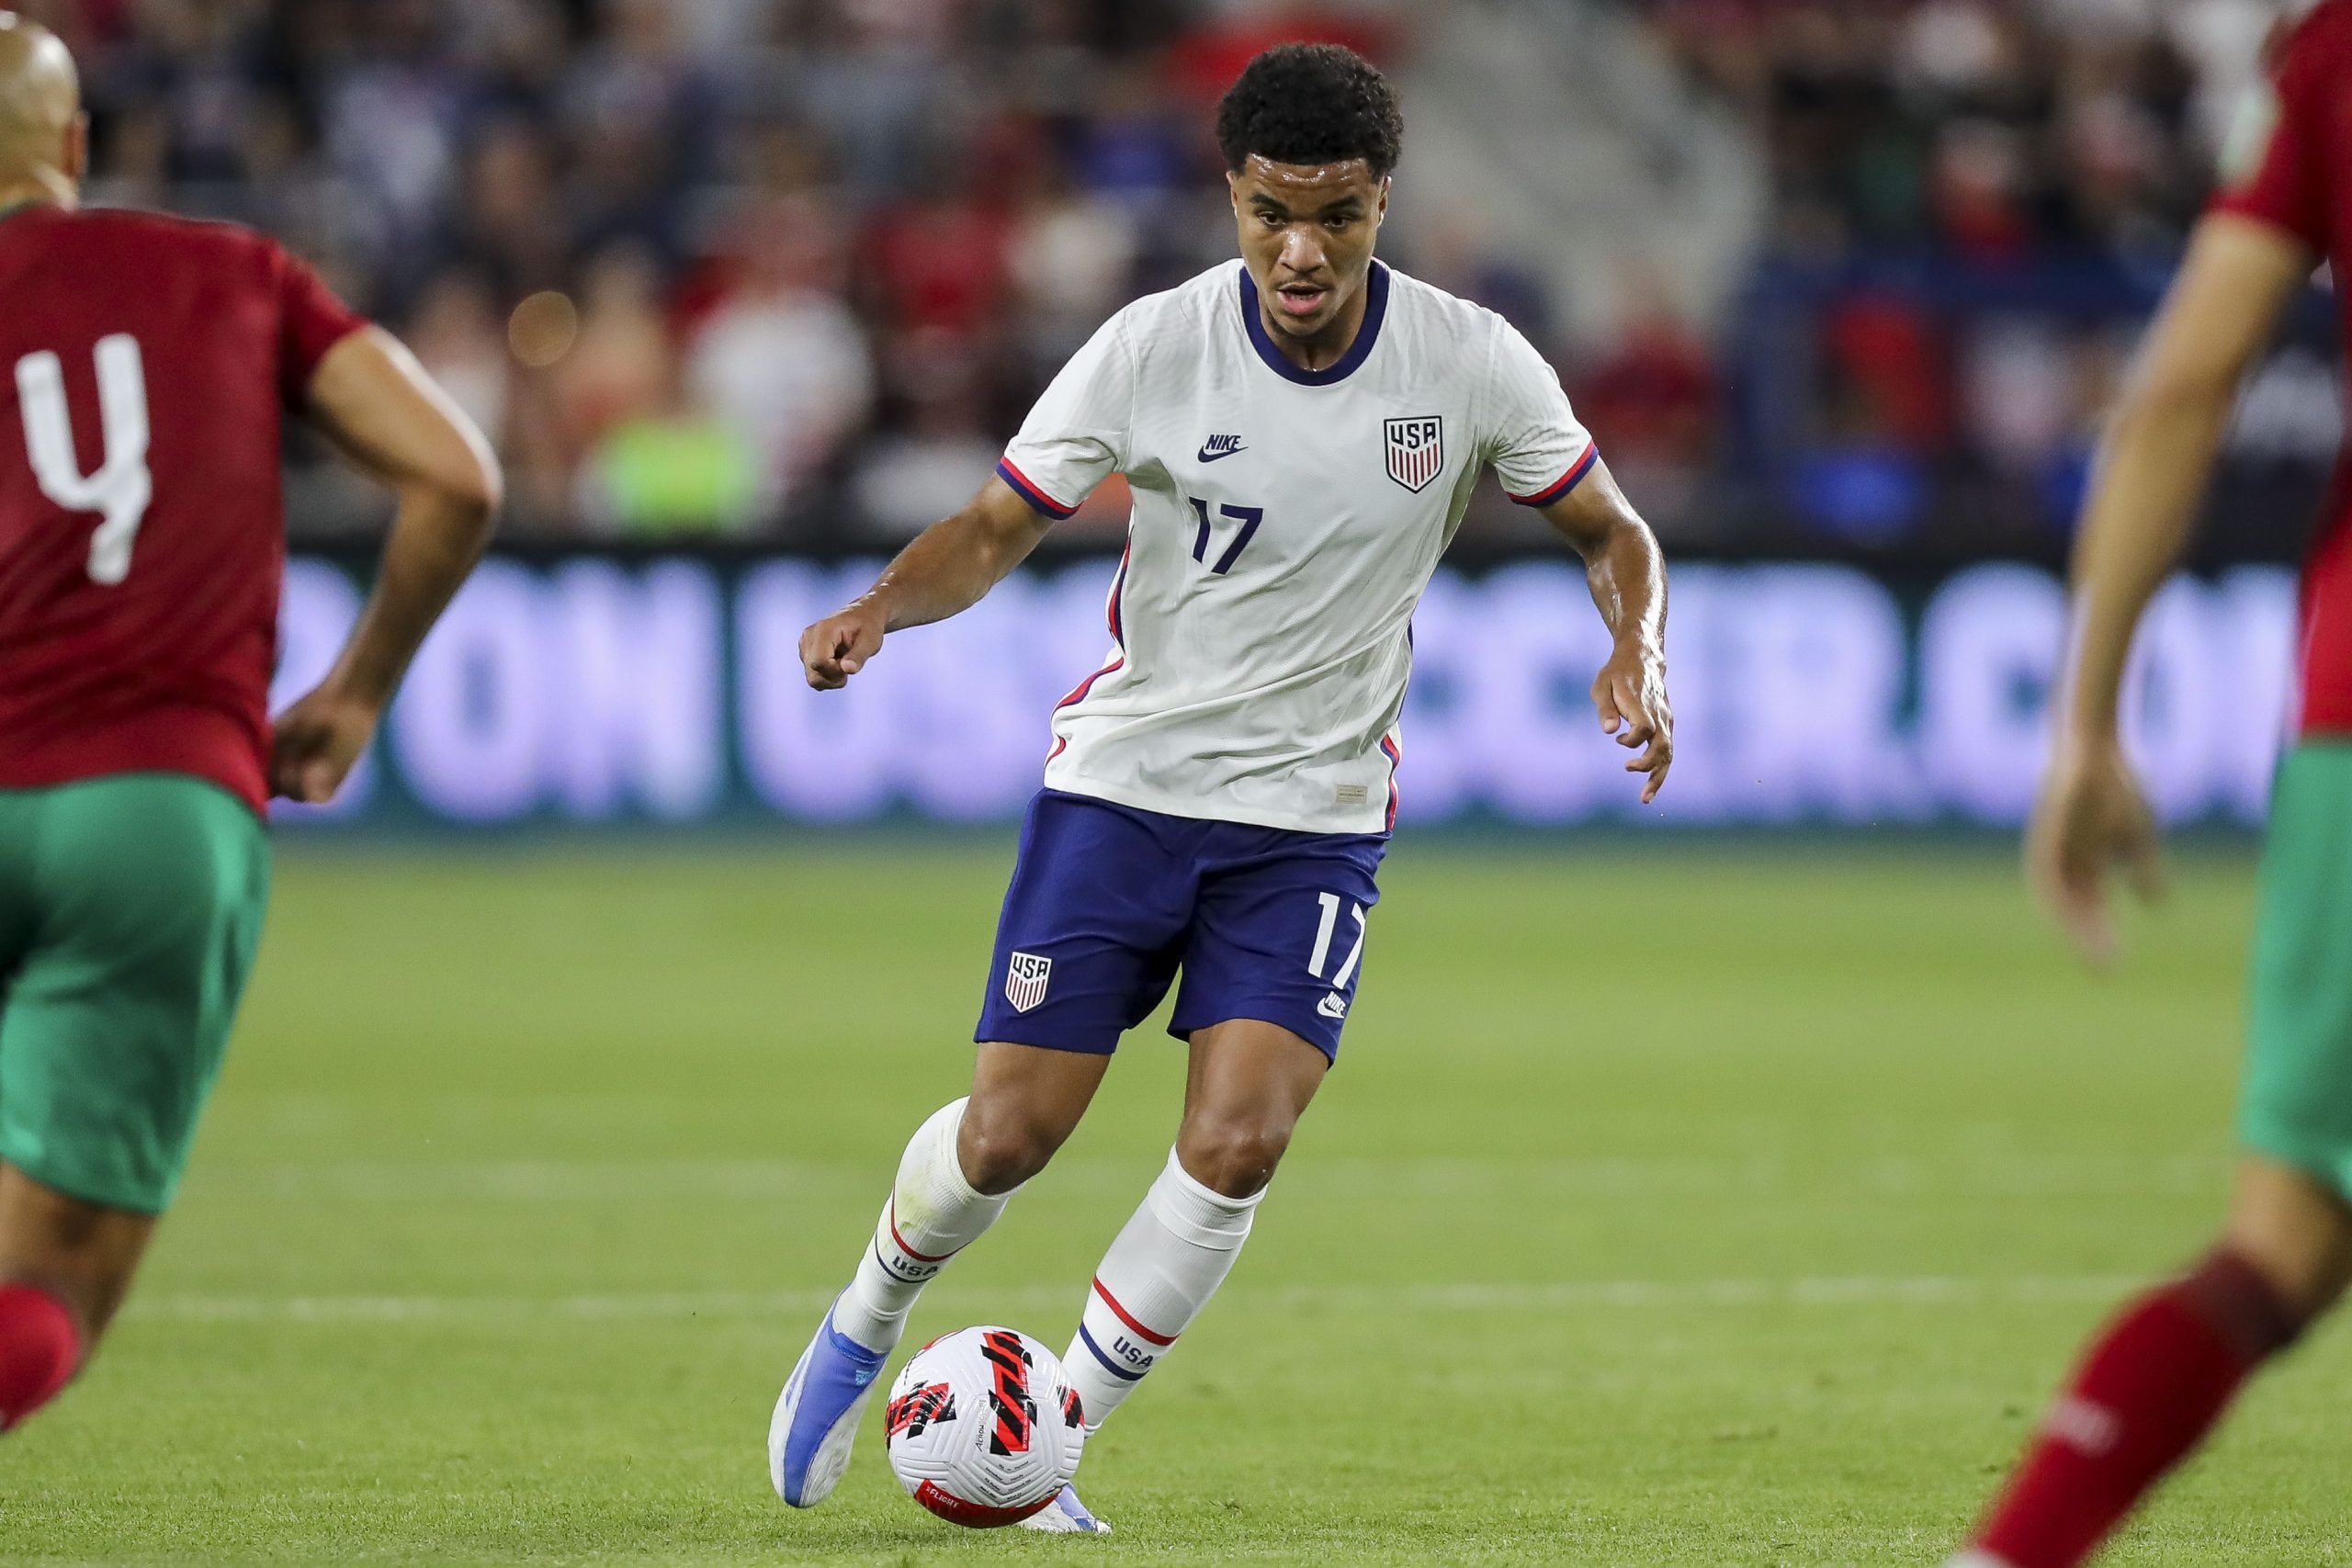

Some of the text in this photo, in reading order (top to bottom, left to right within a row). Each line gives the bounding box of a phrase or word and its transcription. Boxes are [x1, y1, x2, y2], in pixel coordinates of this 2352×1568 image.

[1205, 434, 1241, 451] NIKE
[1390, 422, 1437, 450] USA
[15, 332, 153, 586] 4
[1189, 496, 1264, 575] 17
[1307, 891, 1367, 990] 17
[1012, 955, 1049, 980] USA
[1324, 990, 1347, 1016] NIKE
[892, 1256, 938, 1276] USA
[1113, 1336, 1154, 1367] USA
[929, 1488, 959, 1508] FLIGHT
